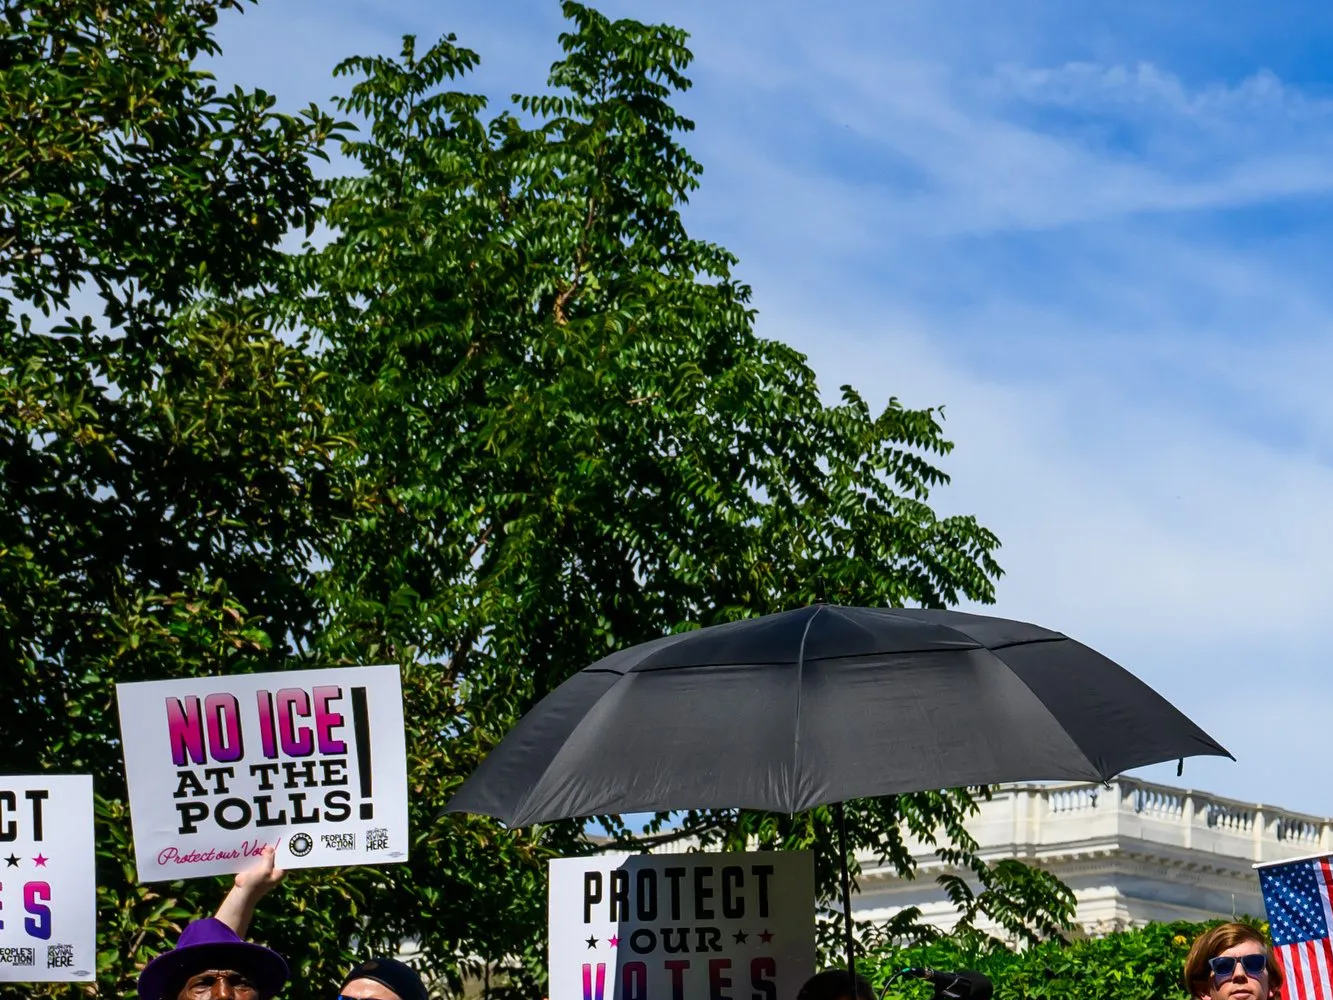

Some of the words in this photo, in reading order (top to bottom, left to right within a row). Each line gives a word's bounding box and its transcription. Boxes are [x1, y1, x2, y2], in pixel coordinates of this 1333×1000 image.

[165, 692, 245, 766] NO
[256, 685, 346, 759] ICE
[173, 766, 235, 798] AT
[250, 759, 348, 789] THE
[158, 846, 215, 865] Protect
[215, 850, 241, 861] our
[241, 837, 281, 857] Vot!
[366, 839, 389, 852] HERE
[584, 865, 774, 923] PROTECT
[630, 927, 722, 954] OUR
[47, 956, 74, 969] HERE
